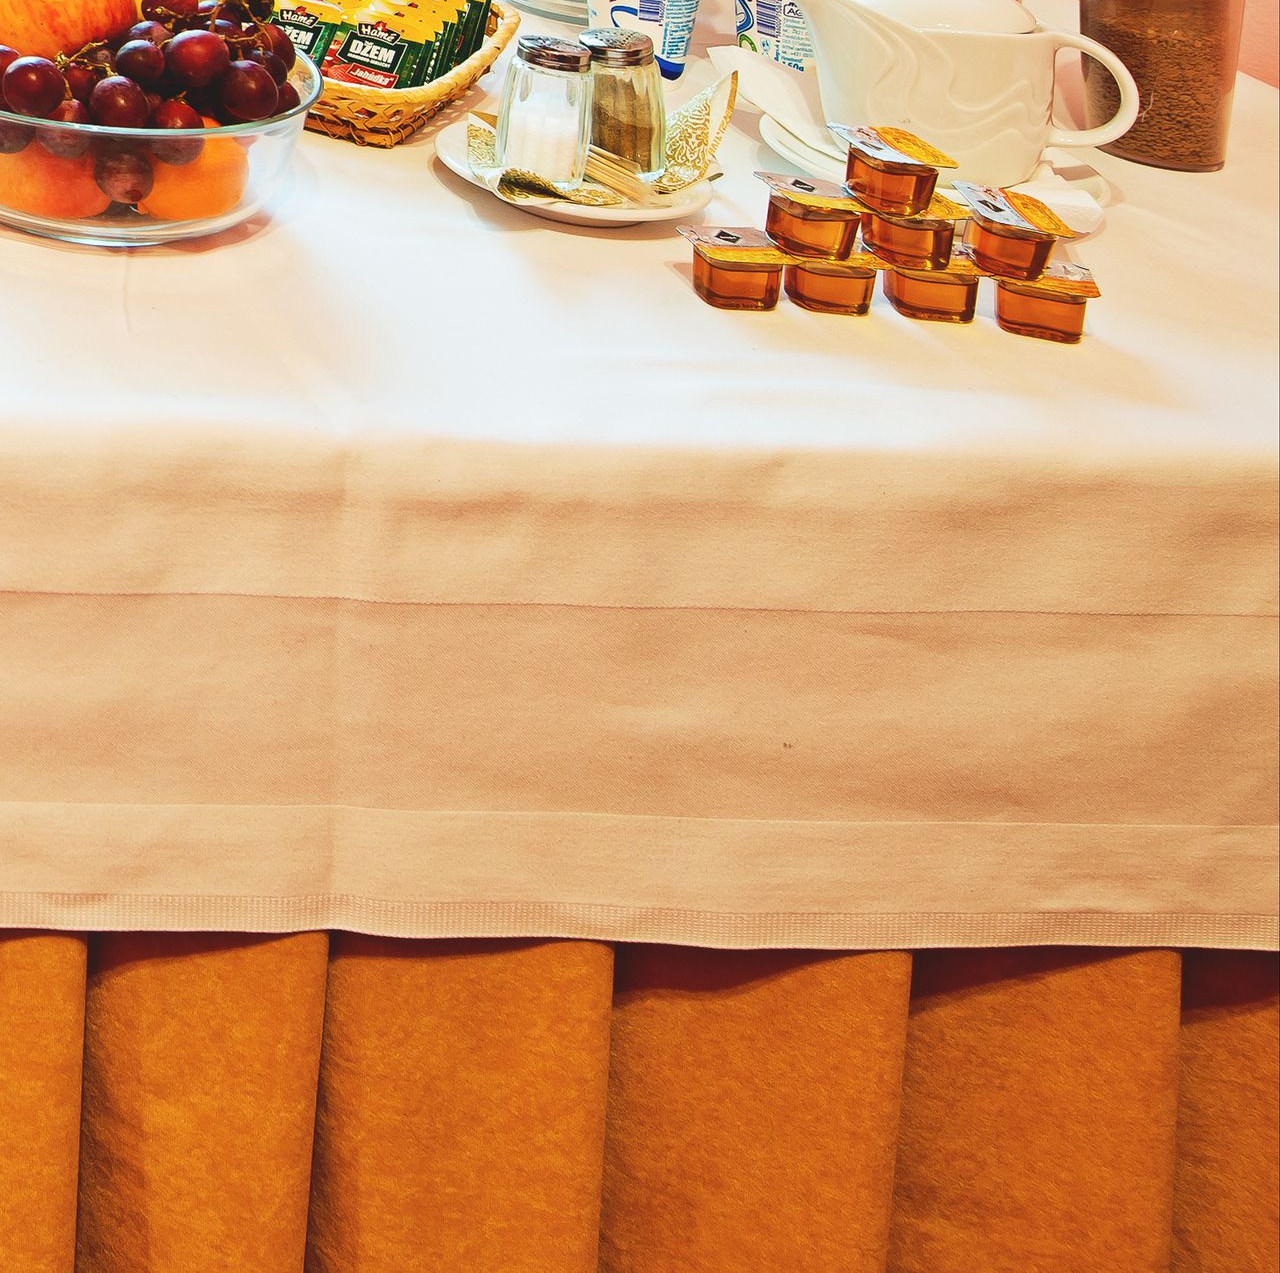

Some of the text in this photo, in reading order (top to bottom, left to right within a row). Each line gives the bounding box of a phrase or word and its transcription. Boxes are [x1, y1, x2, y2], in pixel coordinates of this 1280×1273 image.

[282, 10, 316, 26] Hamé
[787, 6, 804, 17] AG
[281, 25, 314, 46] ŽEM
[361, 24, 397, 41] Hamé
[349, 39, 396, 64] DŽEM
